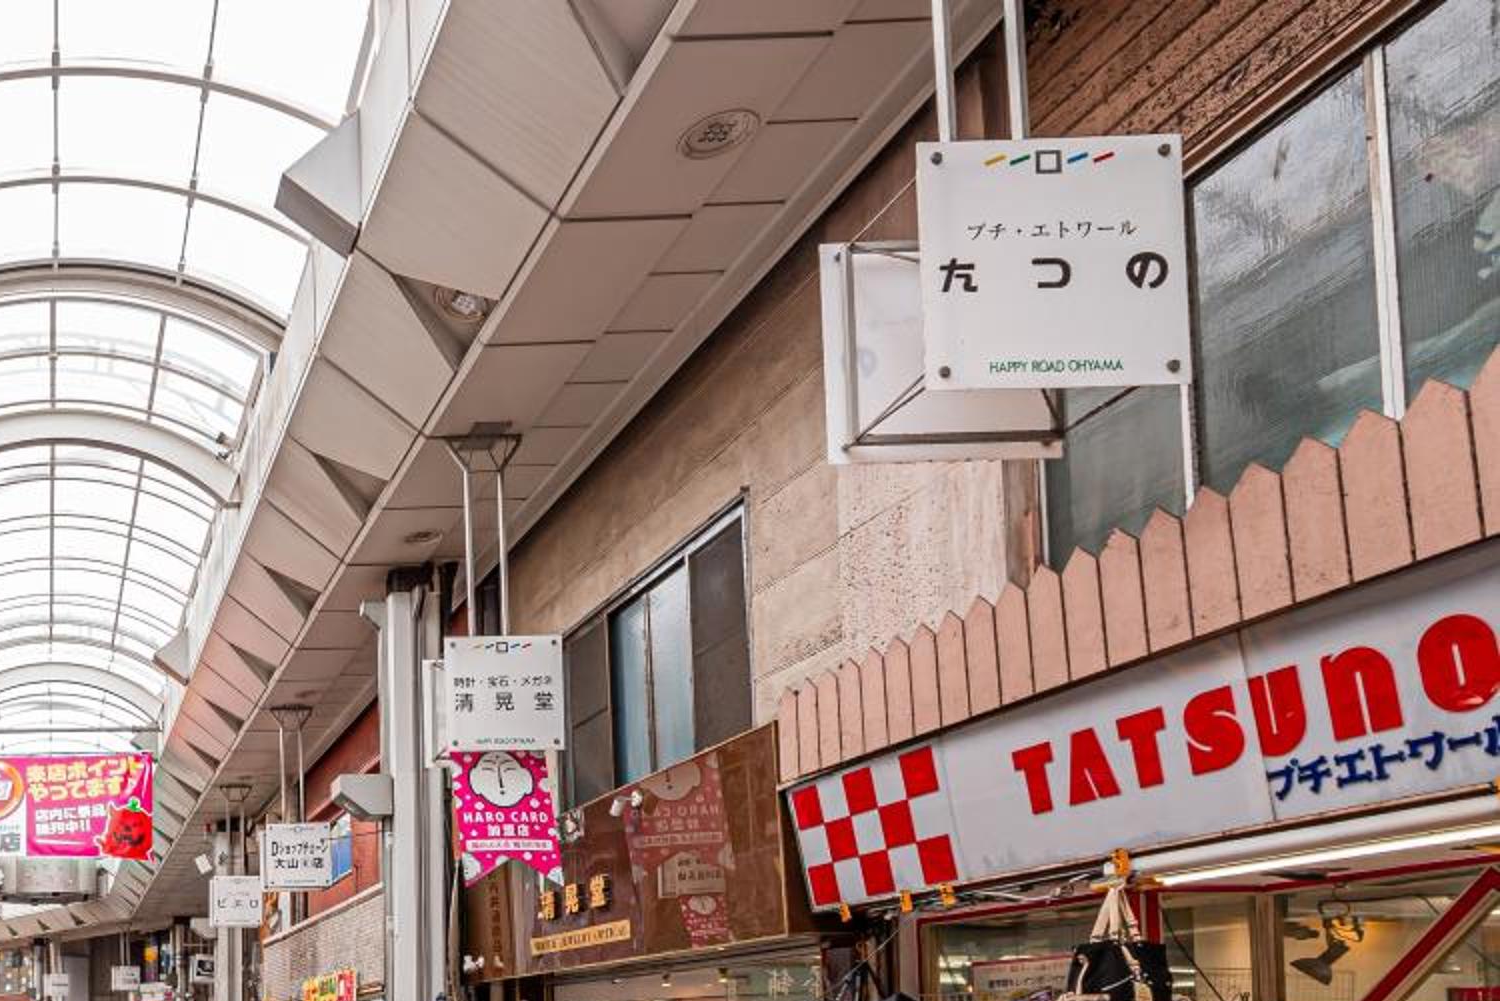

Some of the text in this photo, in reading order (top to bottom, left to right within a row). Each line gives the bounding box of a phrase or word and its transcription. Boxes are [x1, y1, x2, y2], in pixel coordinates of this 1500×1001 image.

[939, 251, 1169, 293] たつの
[989, 359, 1125, 374] HAPPY ROAD OHYAMA
[27, 777, 124, 801] やってます
[463, 811, 548, 824] HARO CARD
